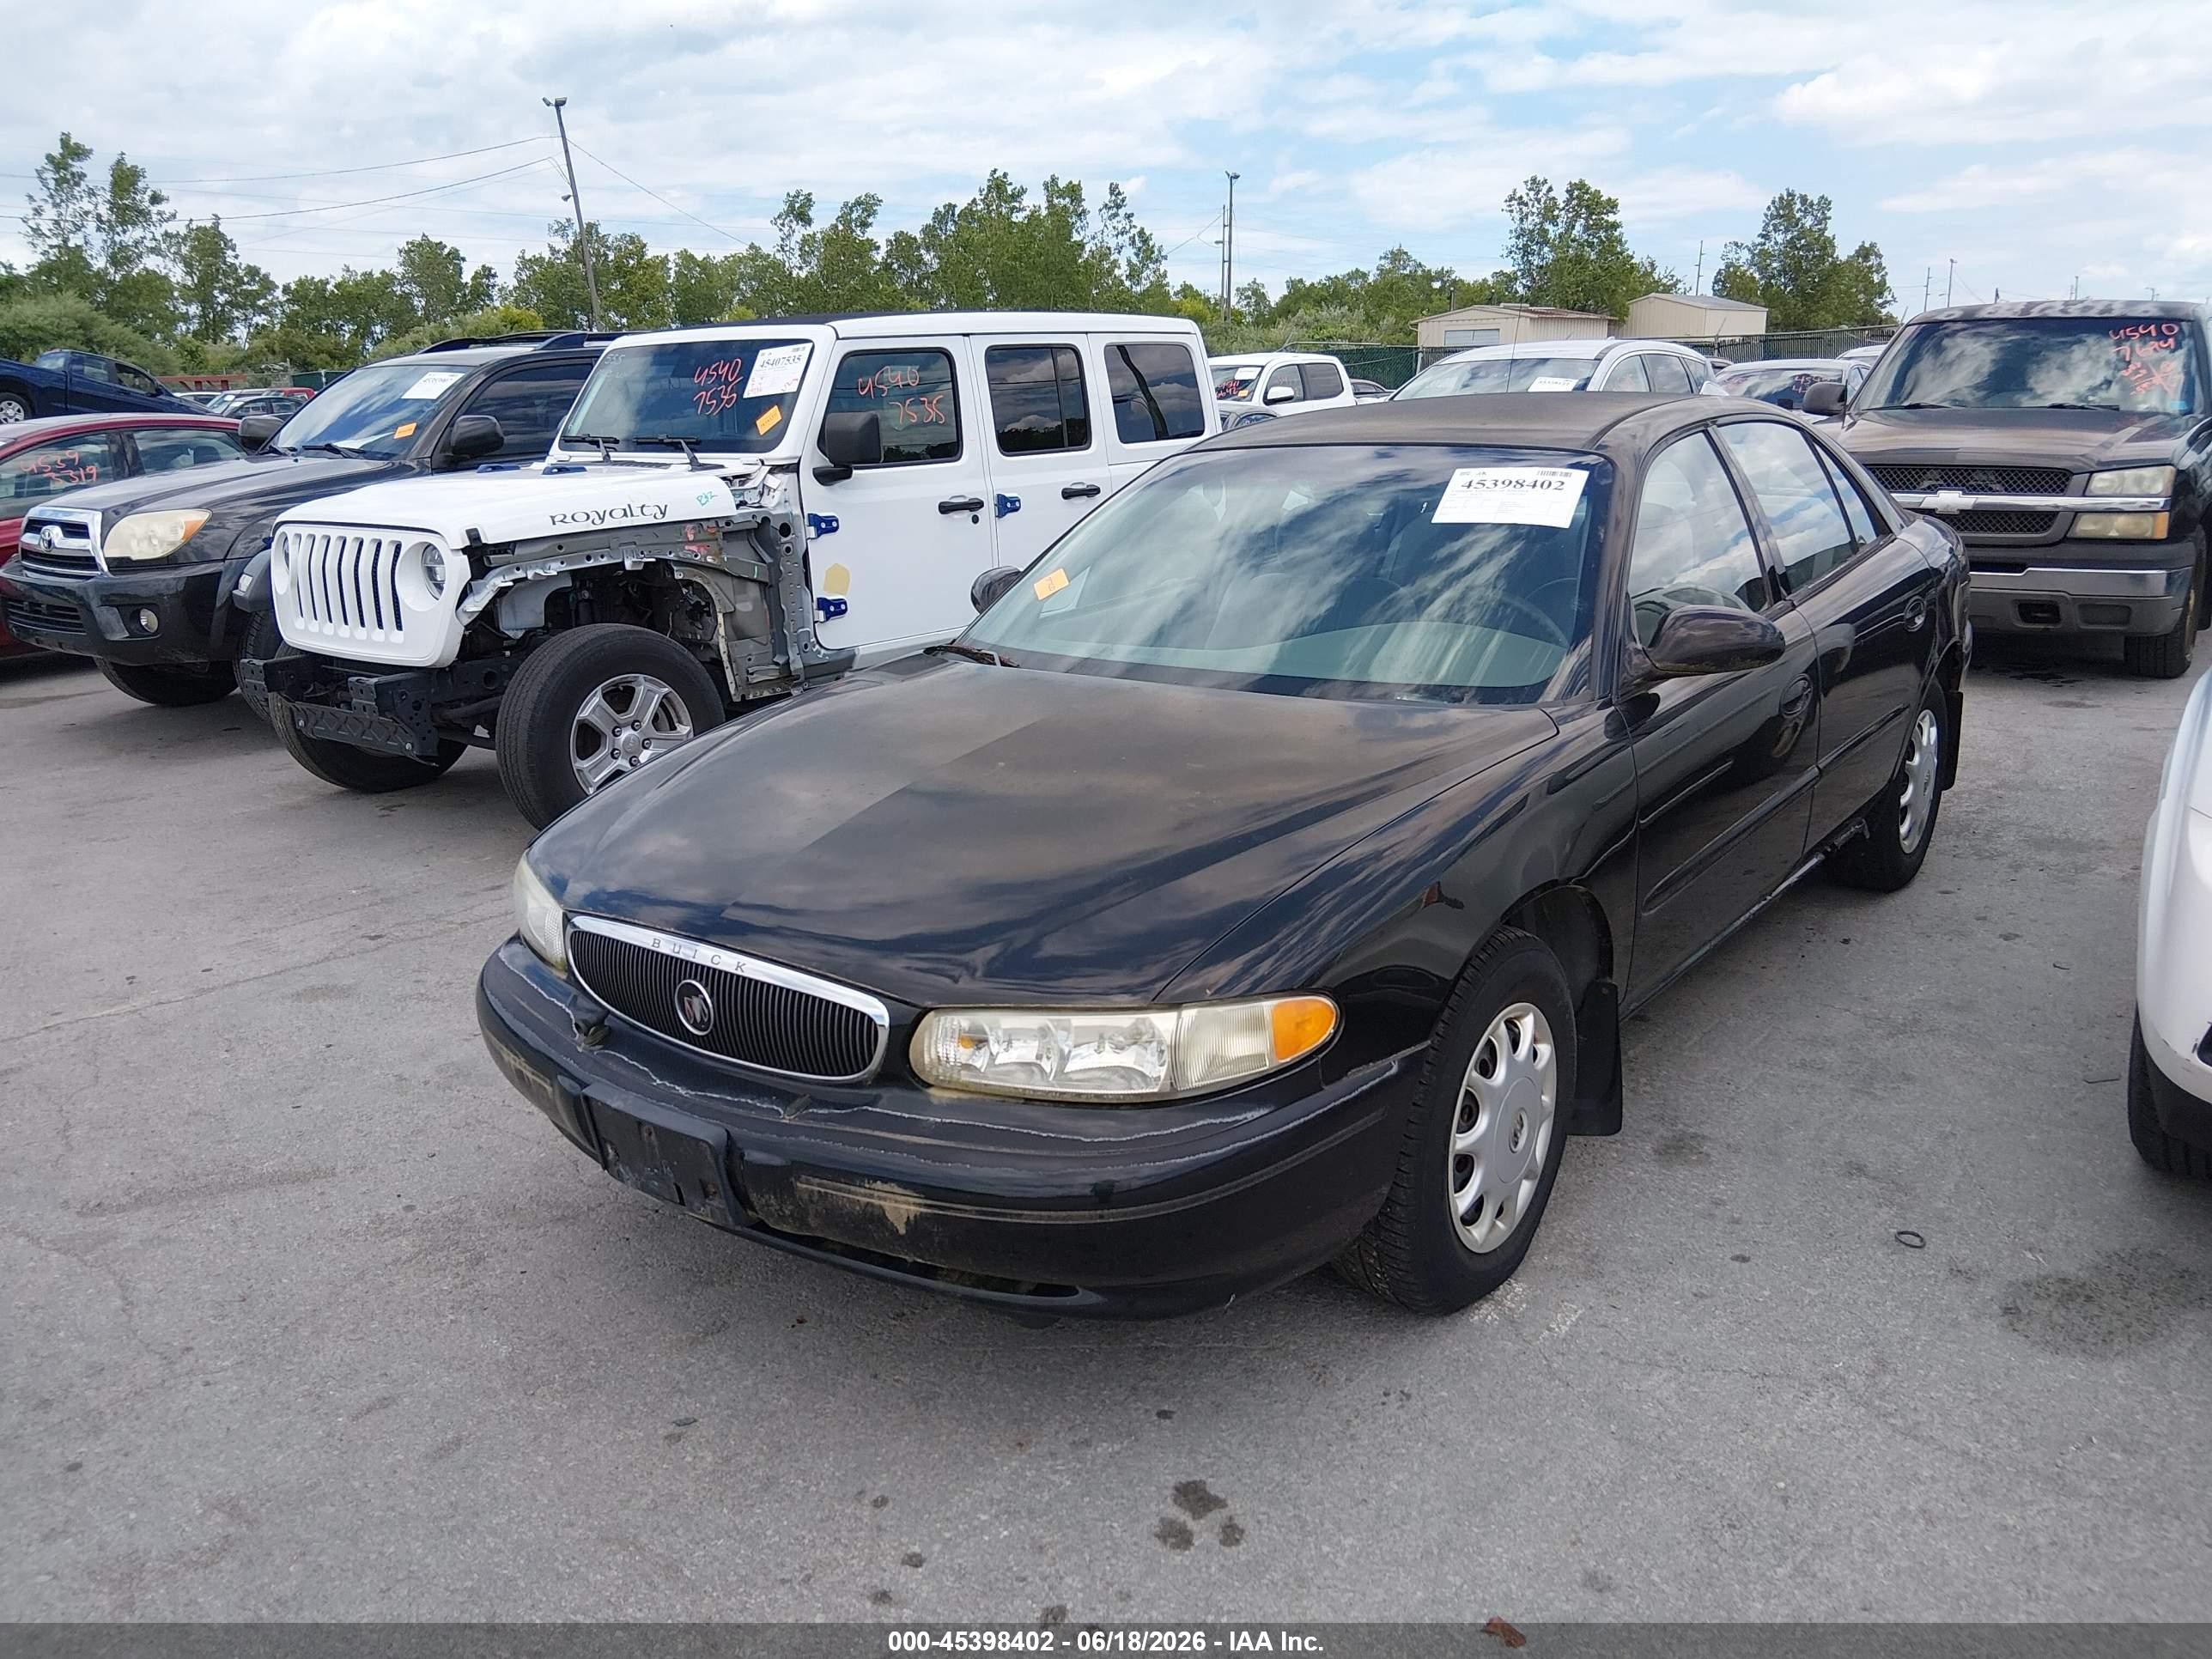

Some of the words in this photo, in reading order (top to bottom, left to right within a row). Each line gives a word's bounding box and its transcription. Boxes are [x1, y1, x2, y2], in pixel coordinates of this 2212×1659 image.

[2109, 323, 2179, 340] 4540
[694, 358, 742, 386] 4540
[760, 355, 803, 368] 45407535
[693, 376, 744, 416] 7535
[858, 365, 920, 399] 4540
[888, 395, 945, 423] 7535
[20, 449, 79, 473] 4539
[1461, 478, 1565, 491] 45398402
[652, 938, 747, 973] BUICK
